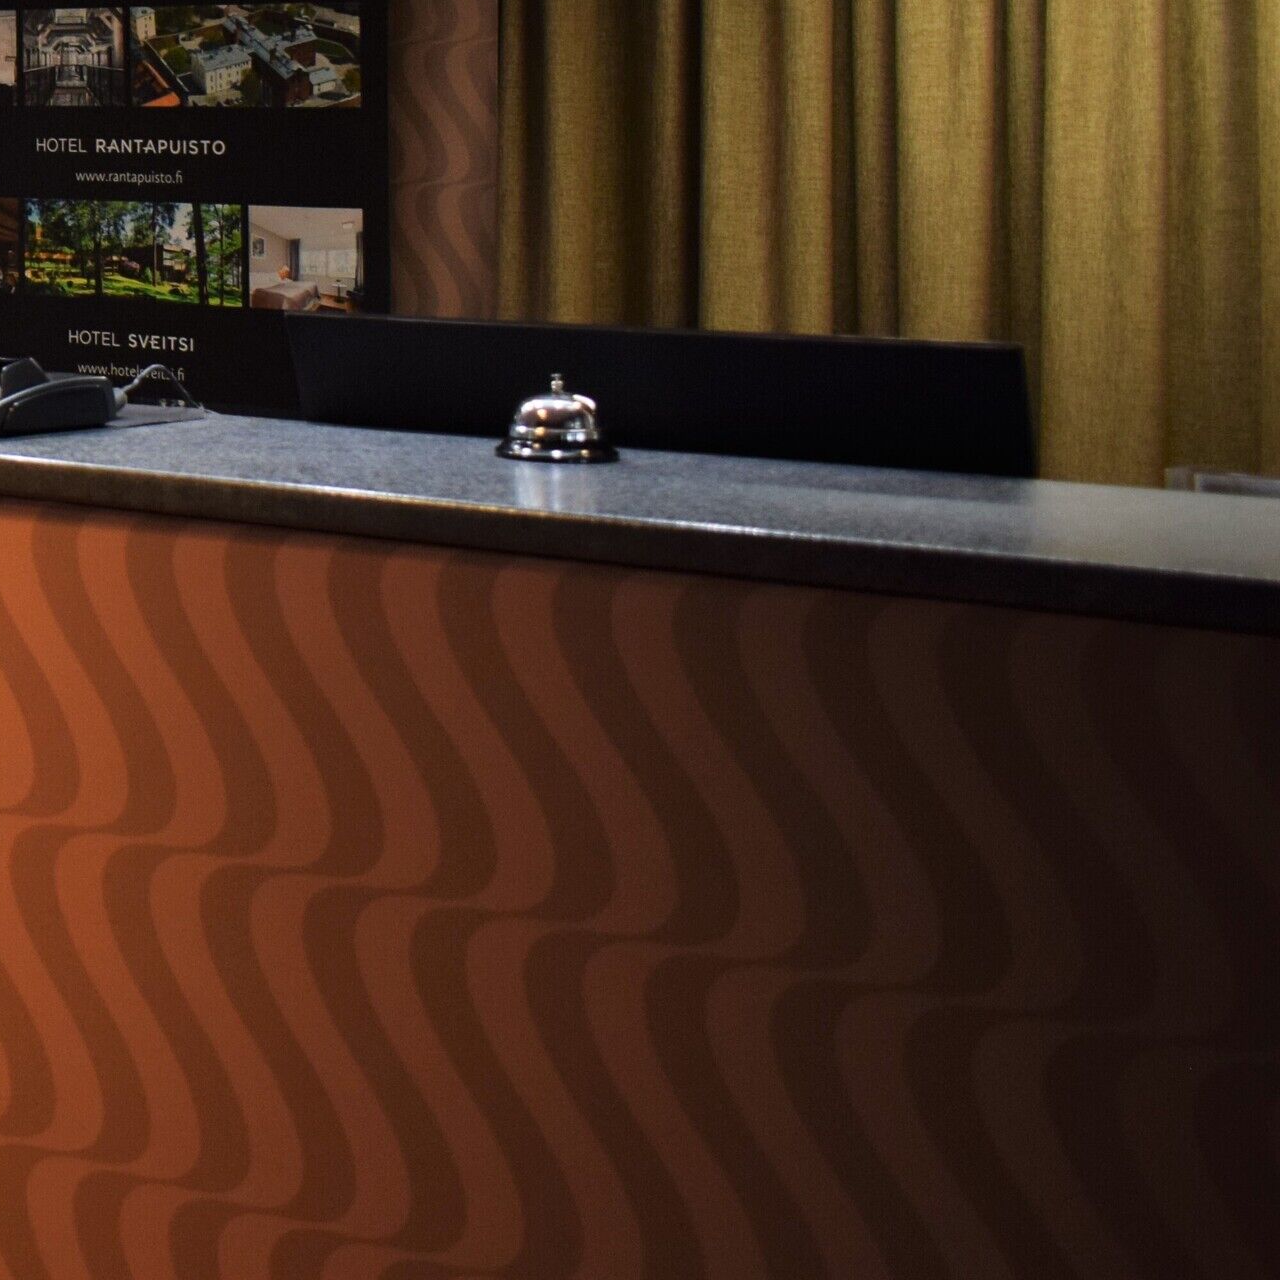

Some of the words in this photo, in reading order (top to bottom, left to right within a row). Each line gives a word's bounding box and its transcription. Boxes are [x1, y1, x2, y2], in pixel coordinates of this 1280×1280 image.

[35, 138, 88, 153] HOTEL
[95, 138, 226, 156] RANTAPUISTO
[75, 170, 183, 186] www.rantapuisto.fi
[68, 329, 120, 348] HOTEL
[127, 333, 195, 353] SVEITSI
